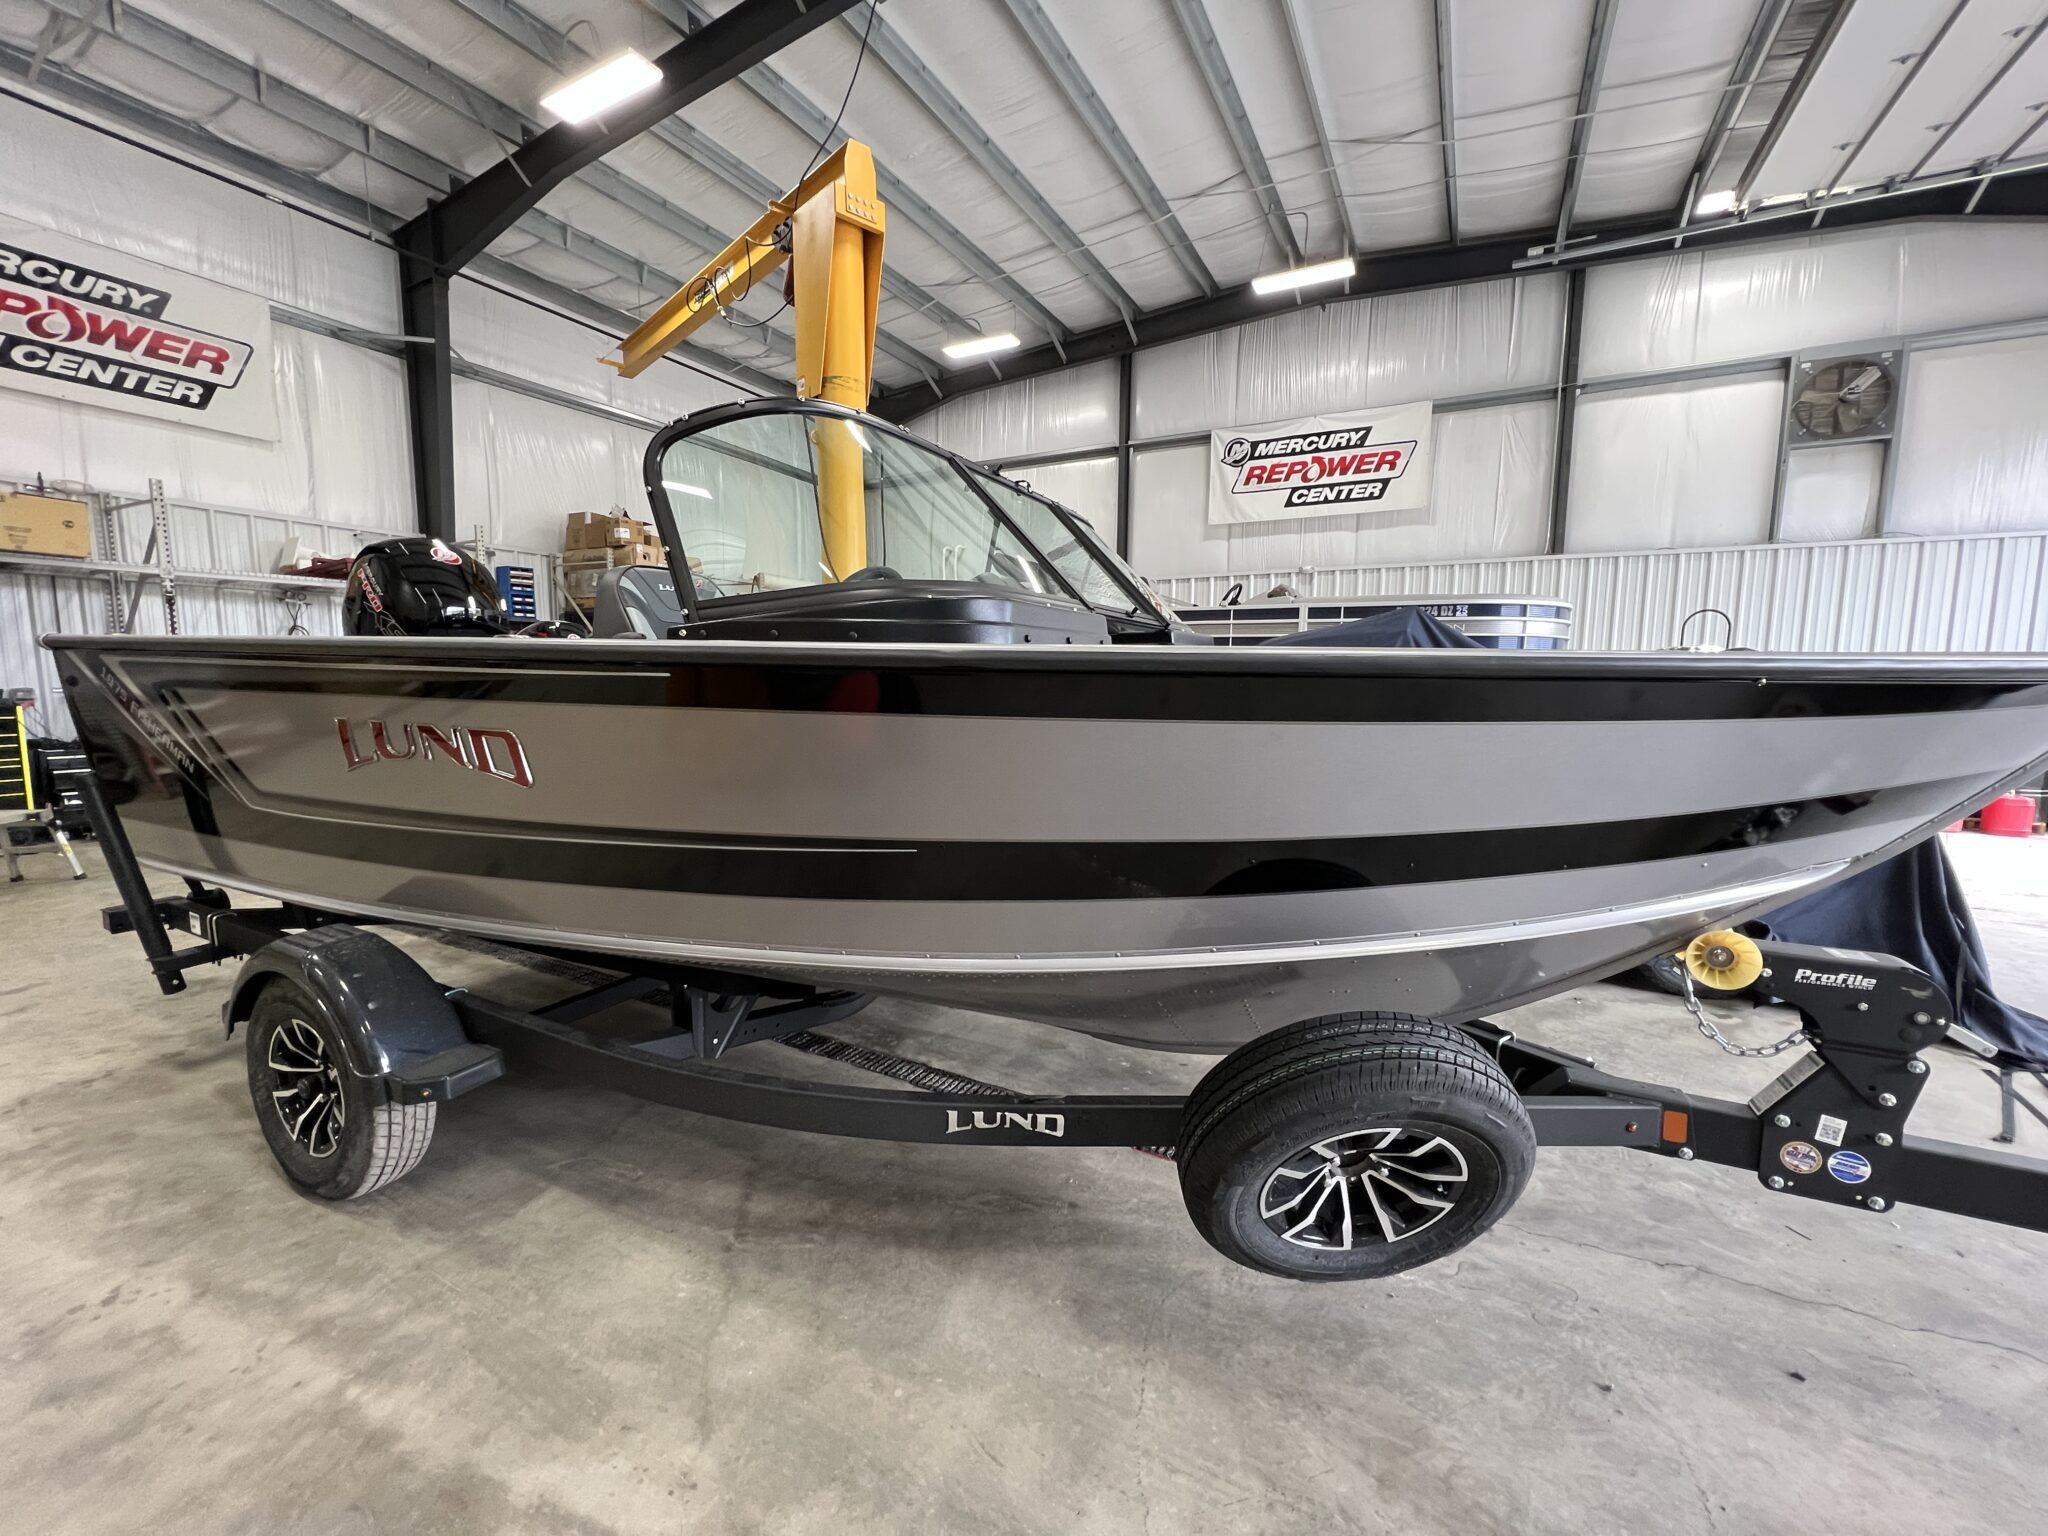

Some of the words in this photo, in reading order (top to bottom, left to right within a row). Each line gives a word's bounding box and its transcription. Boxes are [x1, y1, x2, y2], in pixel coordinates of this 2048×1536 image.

[10, 344, 204, 404] CENTER
[1254, 430, 1366, 457] MERCURY
[1243, 450, 1402, 486] REPOWER
[1291, 482, 1383, 504] CENTER
[1440, 605, 1454, 617] DZ
[101, 666, 128, 702] 1875
[130, 700, 195, 774] FISHERMAN
[334, 717, 535, 788] LUND
[1795, 968, 1877, 987] Profile
[946, 1110, 1065, 1138] LUND
